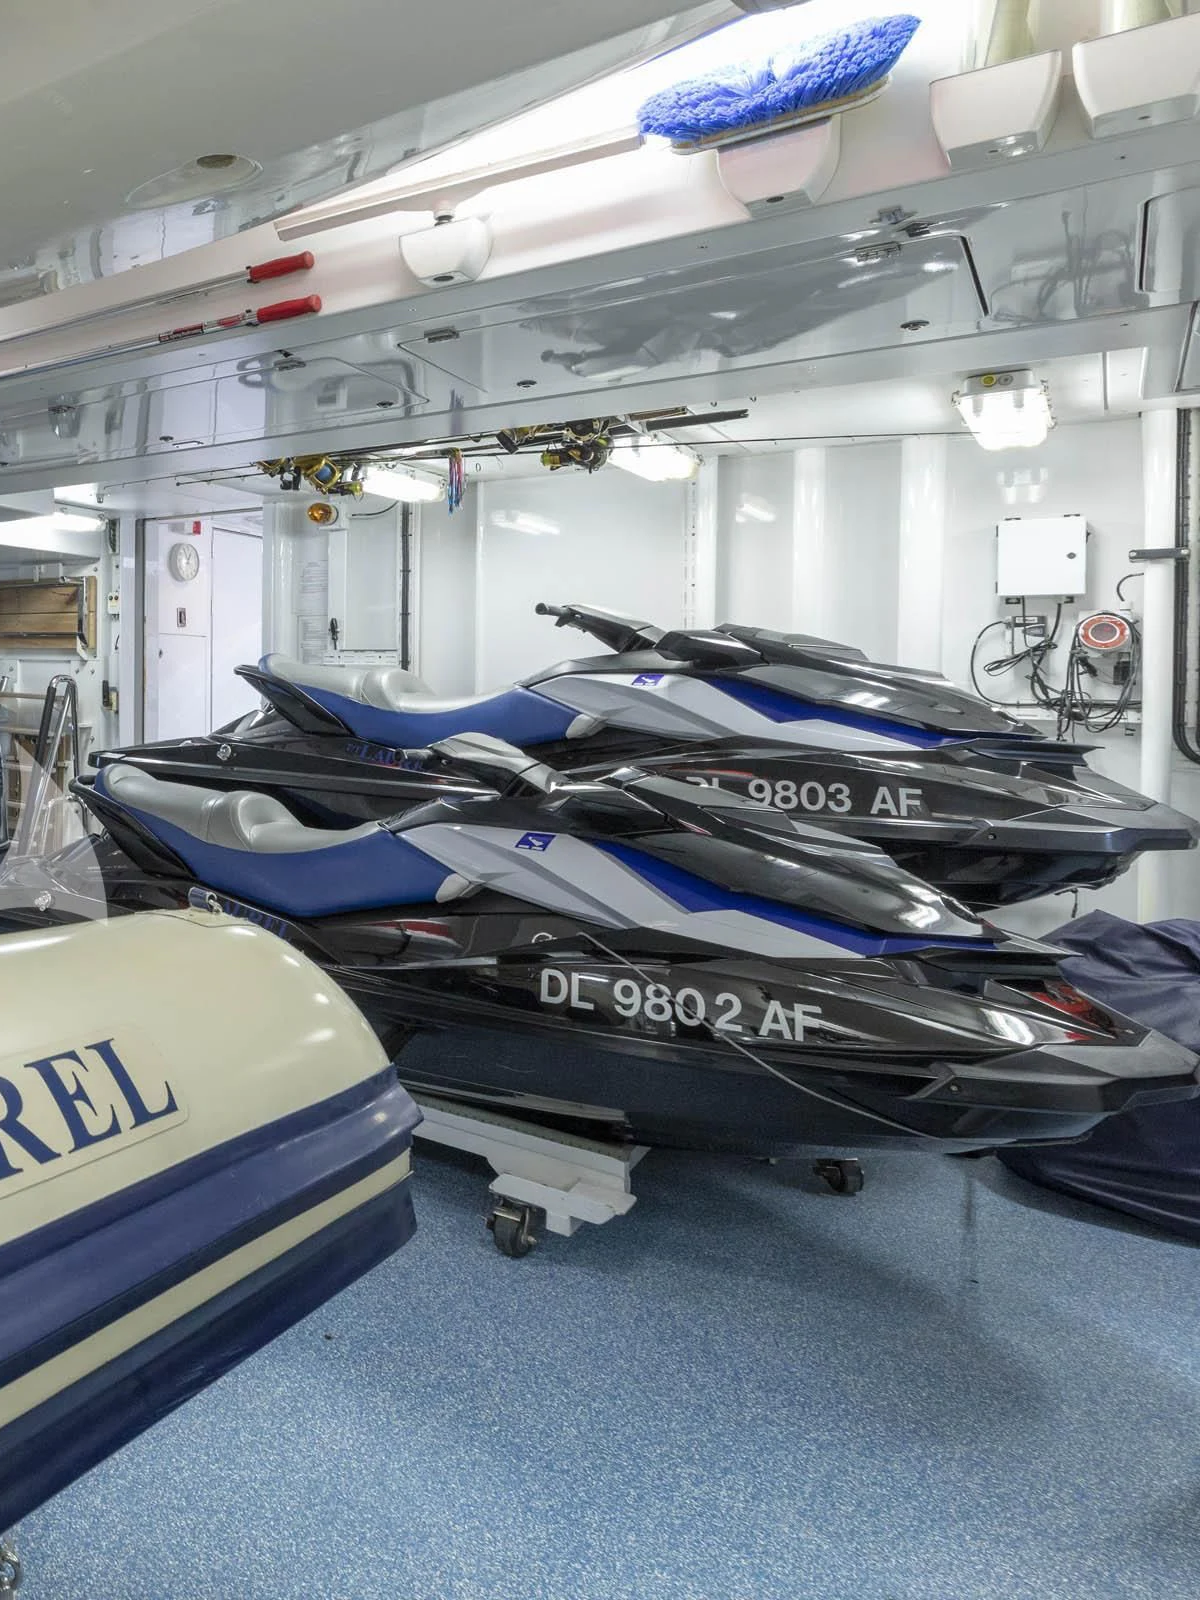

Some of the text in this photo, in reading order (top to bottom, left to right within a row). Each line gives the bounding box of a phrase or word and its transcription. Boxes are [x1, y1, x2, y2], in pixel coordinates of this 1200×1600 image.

[748, 778, 922, 817] 9803 AF
[540, 968, 822, 1042] DL 9802 AF
